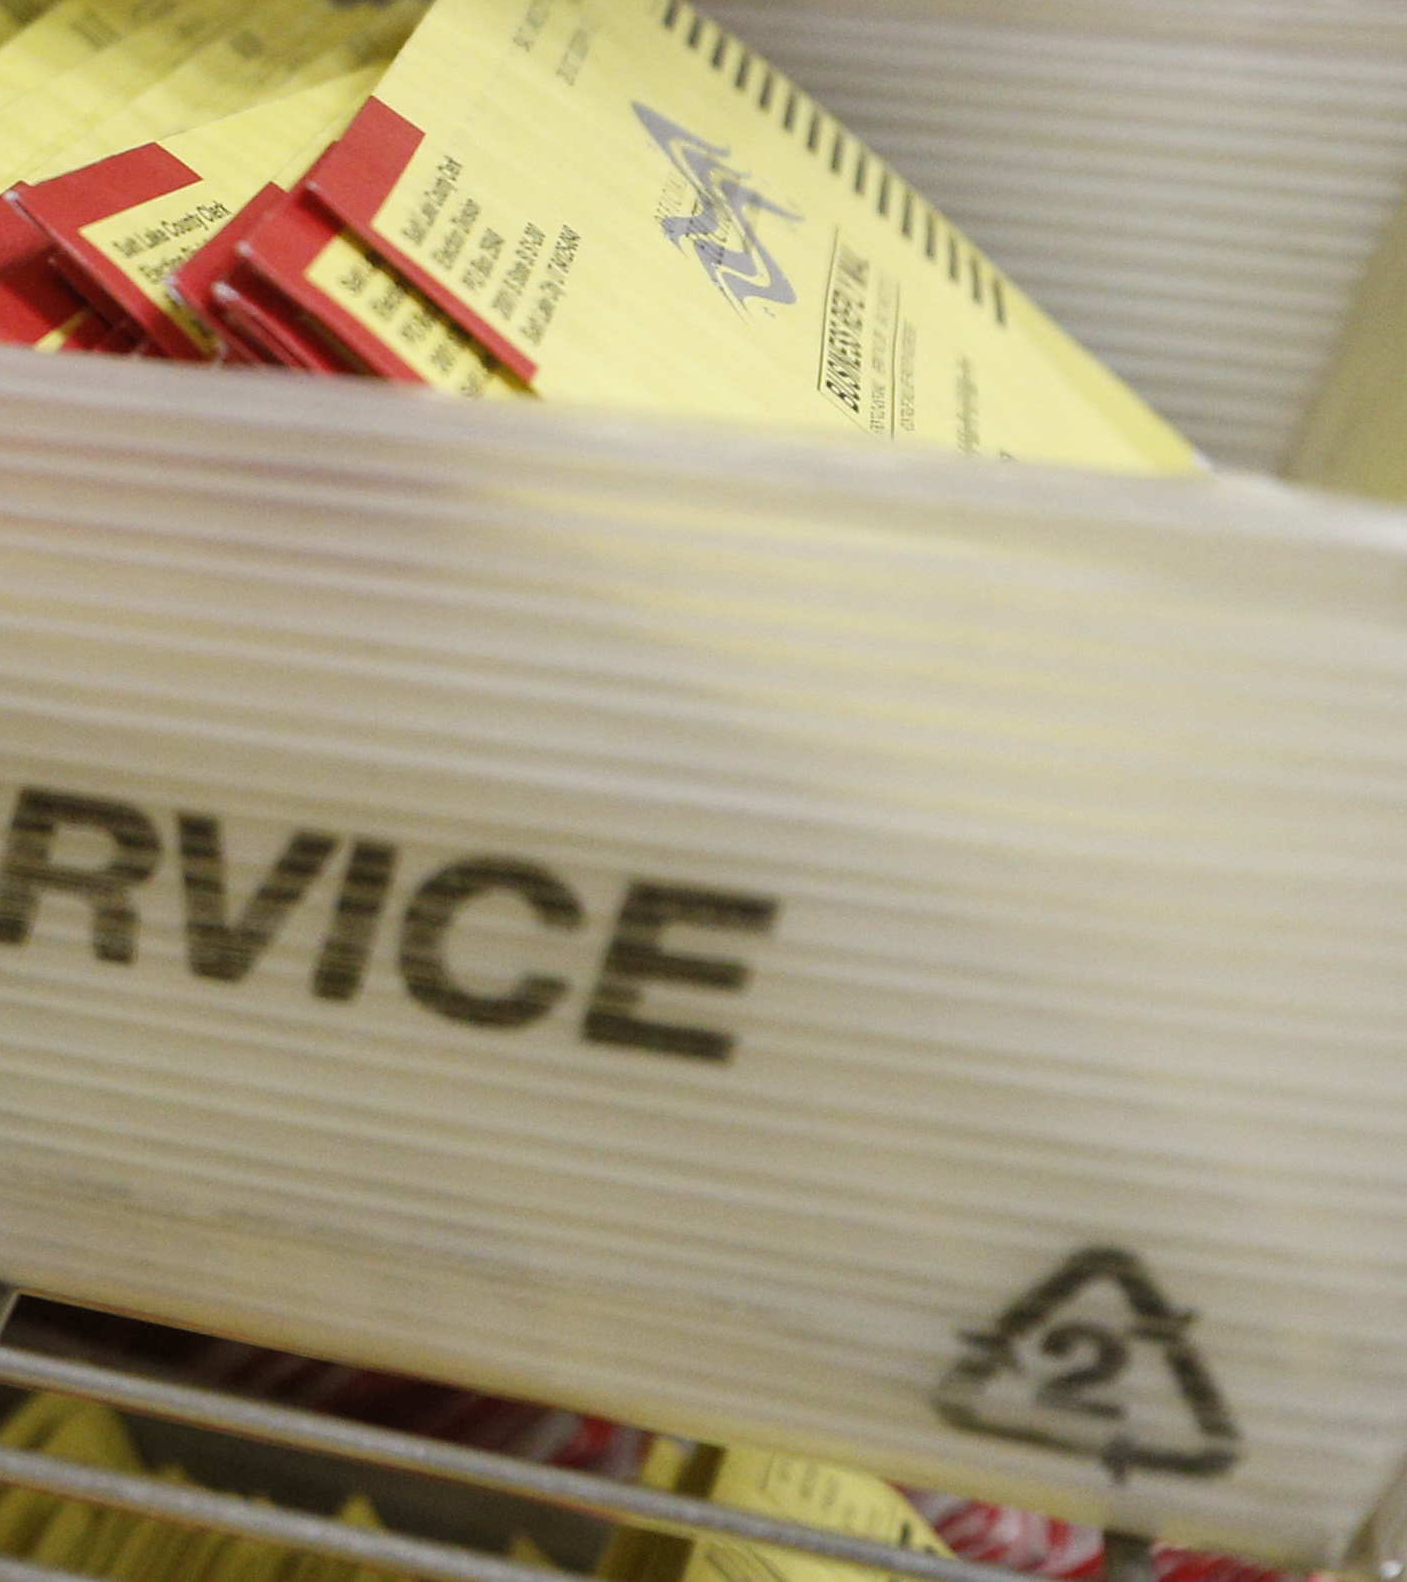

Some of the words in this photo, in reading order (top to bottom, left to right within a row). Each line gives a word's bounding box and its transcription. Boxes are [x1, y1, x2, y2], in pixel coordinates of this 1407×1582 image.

[161, 212, 210, 238] County
[195, 199, 234, 223] Clerk
[1034, 1322, 1131, 1421] 2
